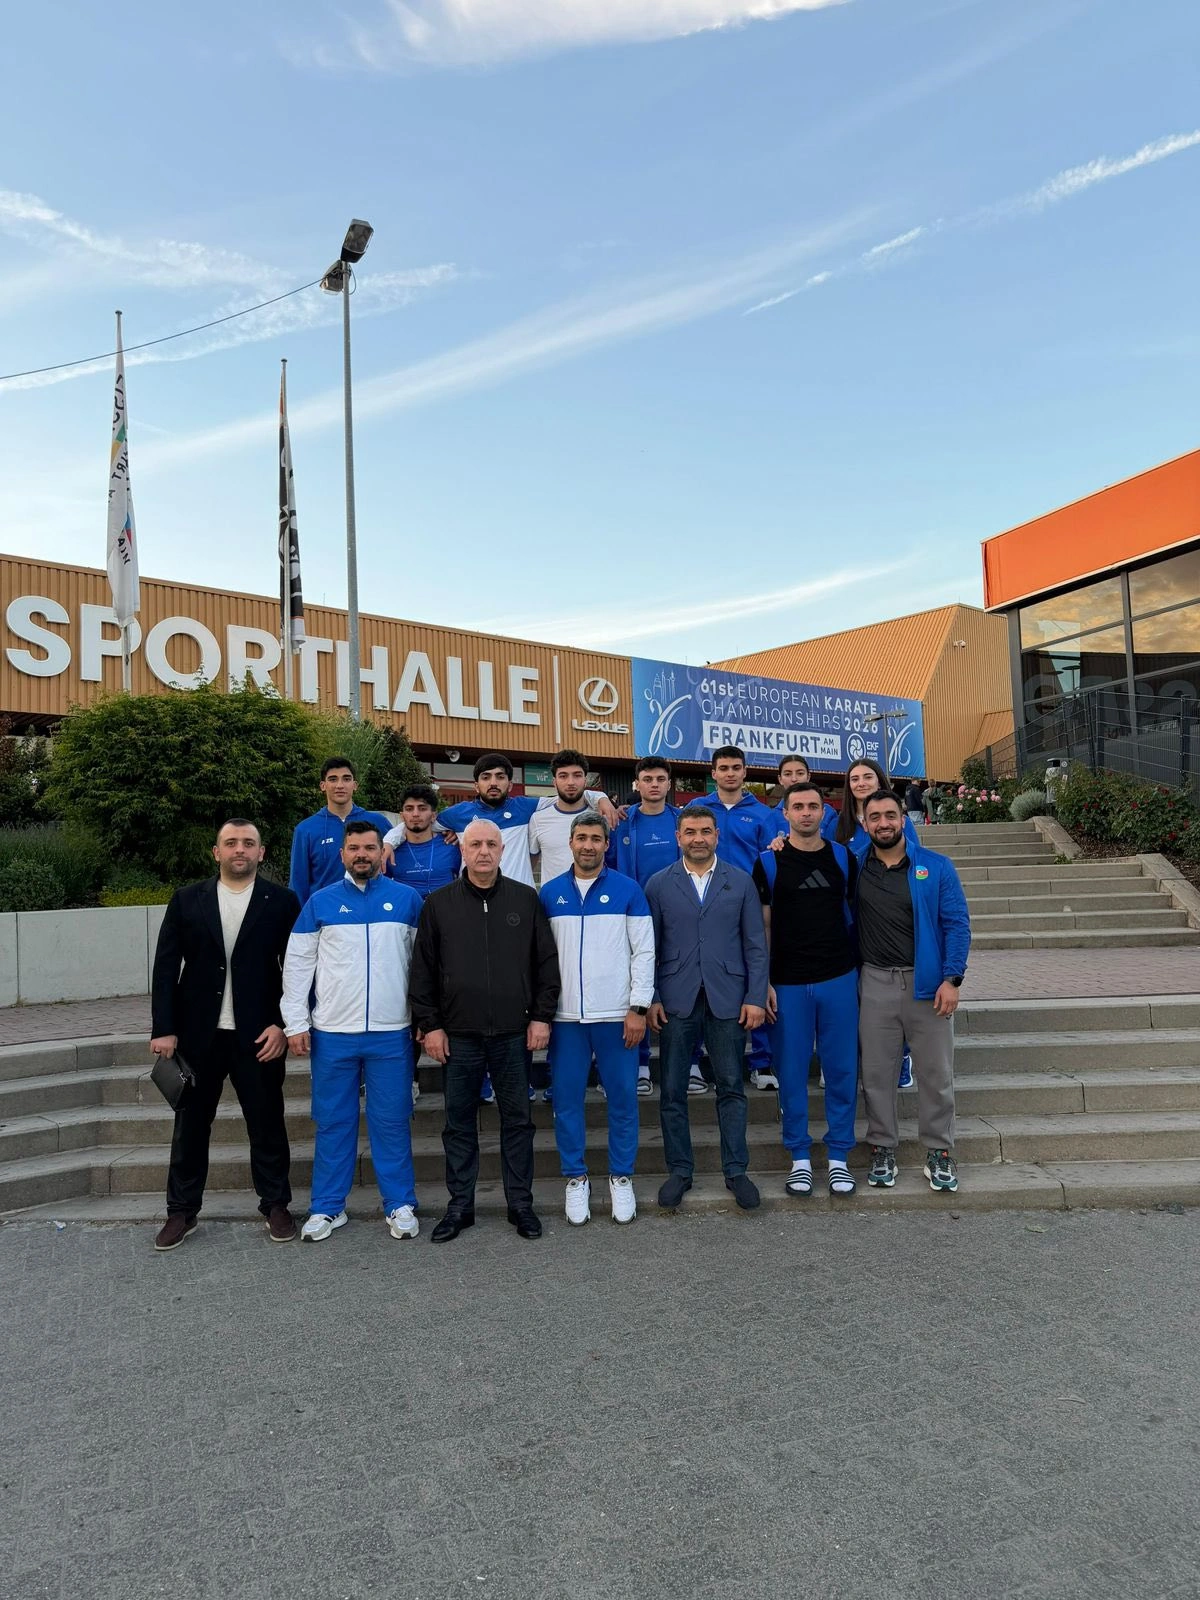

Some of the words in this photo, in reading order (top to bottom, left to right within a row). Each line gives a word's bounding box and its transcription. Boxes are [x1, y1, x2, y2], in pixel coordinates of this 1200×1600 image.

[6, 595, 541, 726] SPORTHALLE
[701, 678, 734, 697] 61st
[738, 684, 820, 709] EUROPEAN
[824, 696, 878, 716] KARATE
[571, 718, 630, 734] LEXUS
[701, 699, 841, 730] CHAMPIONSHIPS
[844, 717, 879, 735] 2026
[709, 725, 821, 755] FRANKFURT
[820, 747, 839, 756] MAIN
[823, 737, 835, 746] AM
[866, 741, 879, 751] EKF
